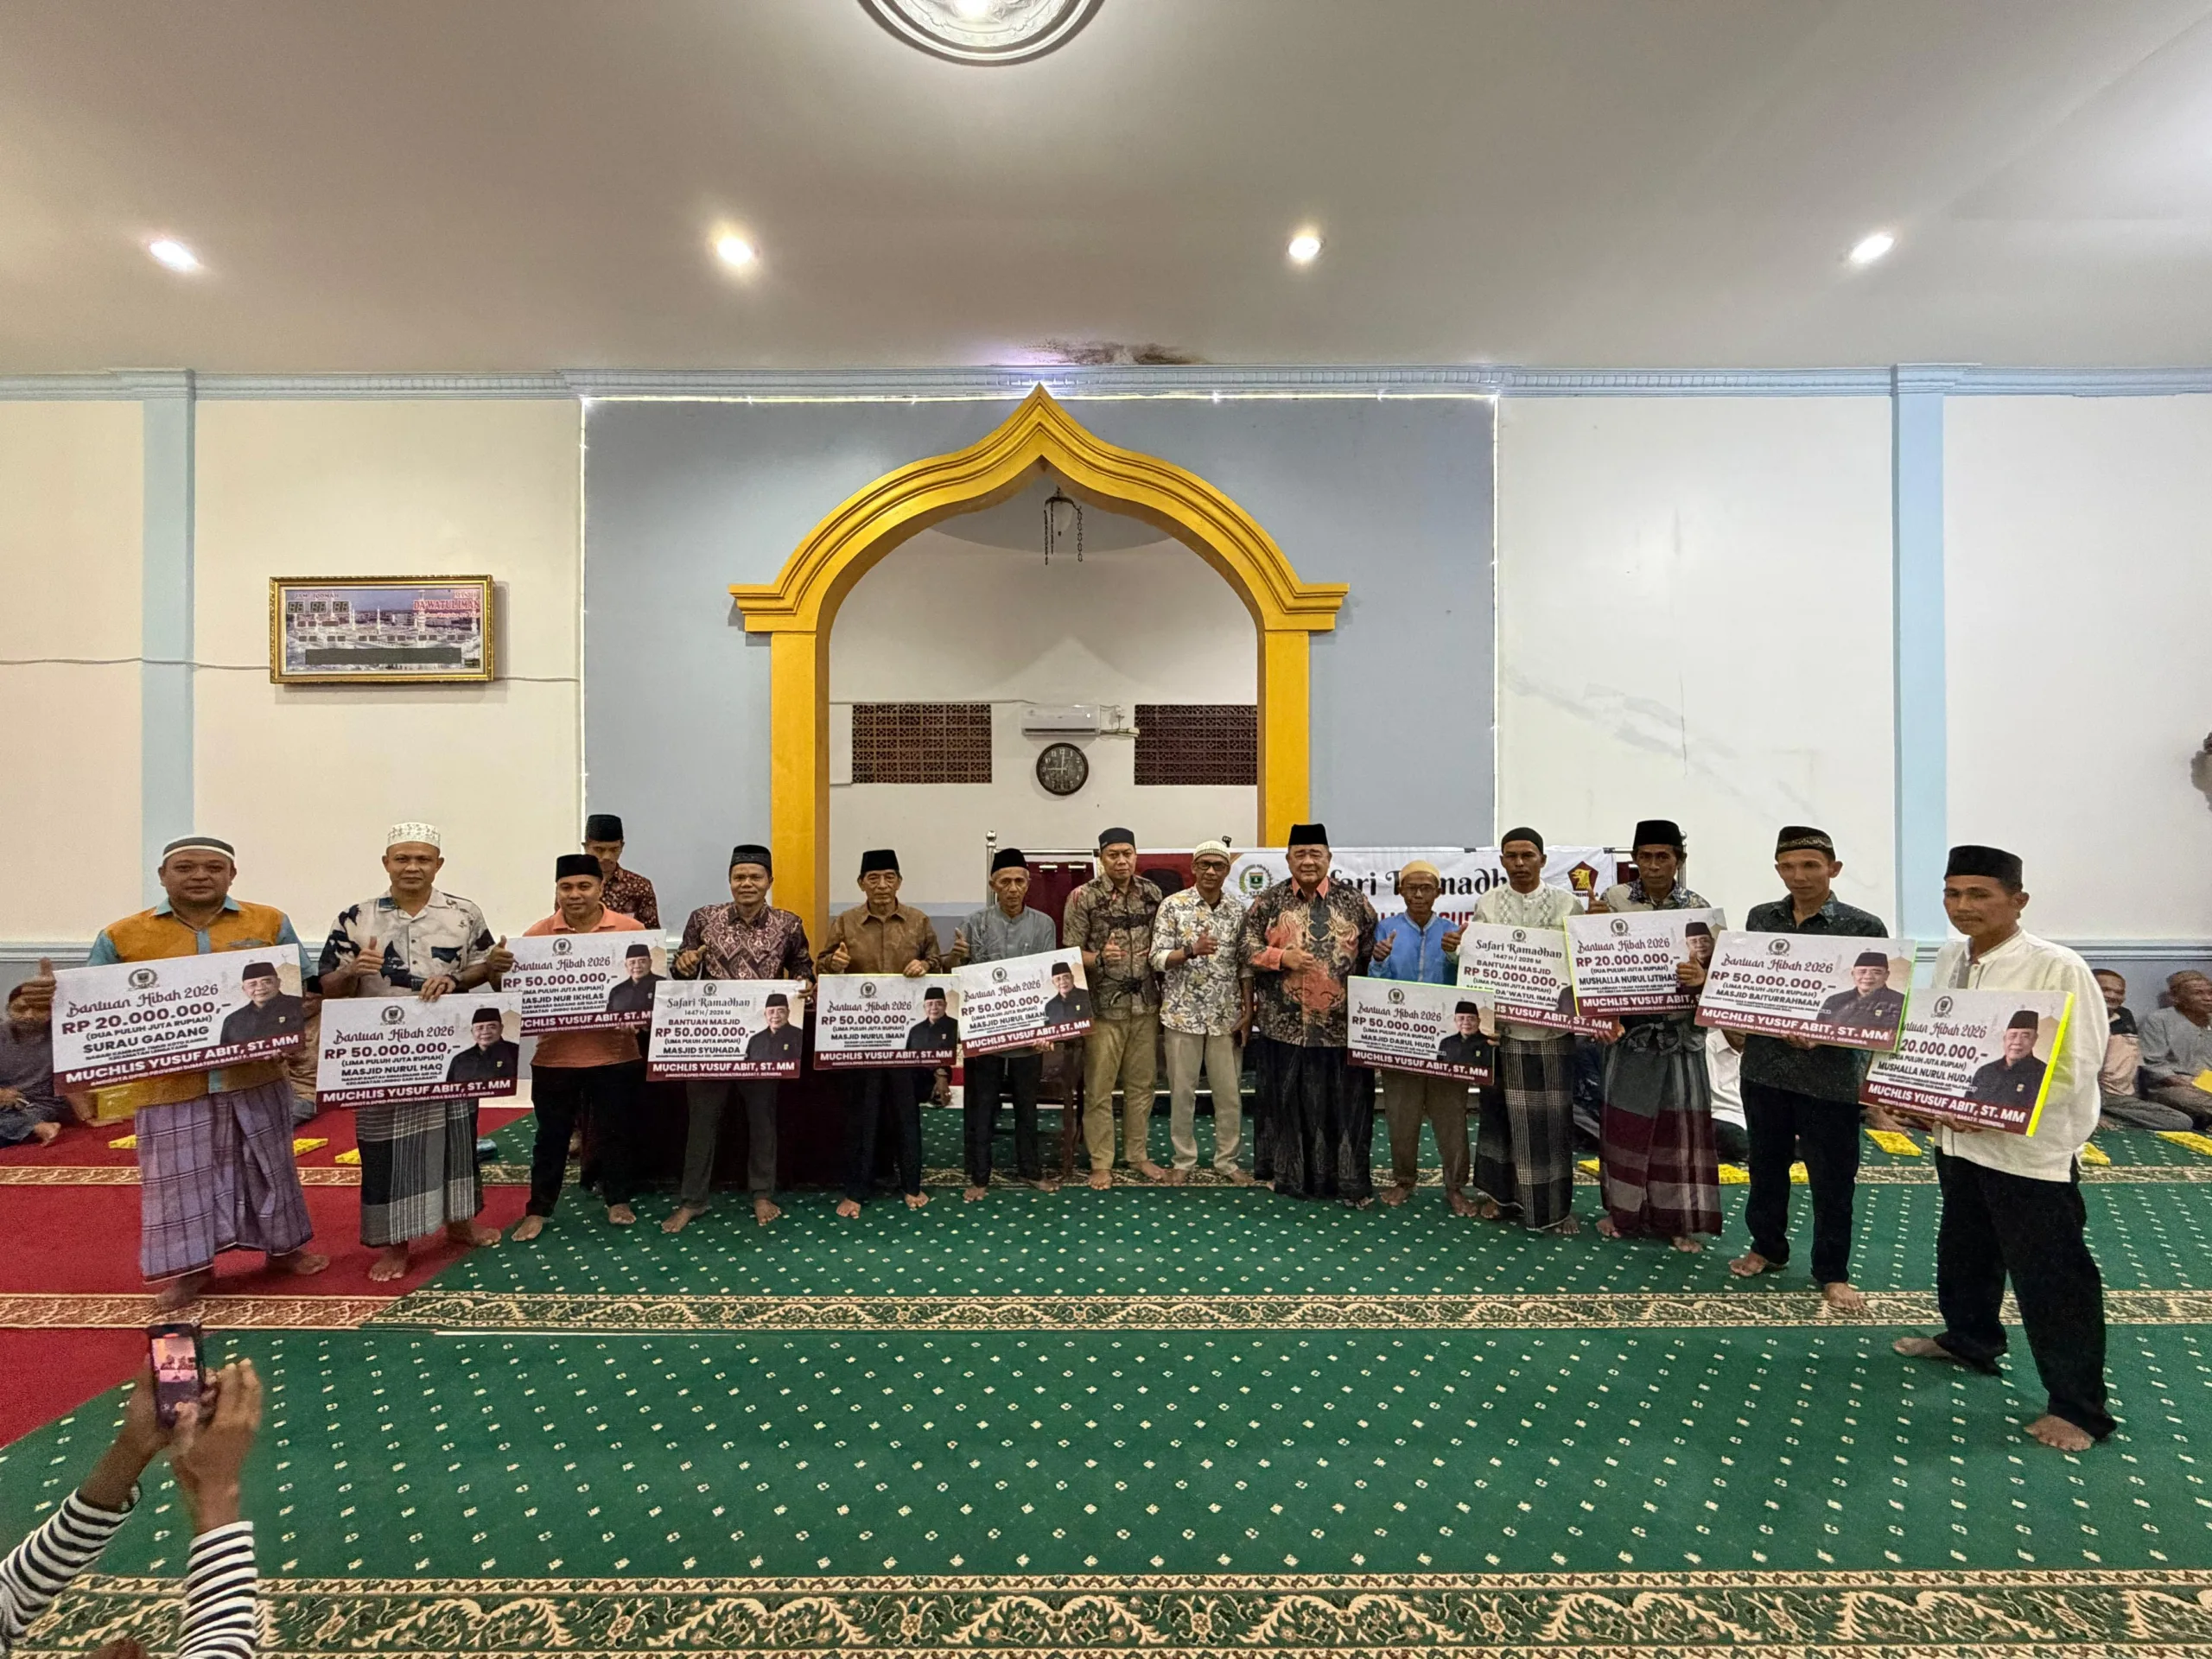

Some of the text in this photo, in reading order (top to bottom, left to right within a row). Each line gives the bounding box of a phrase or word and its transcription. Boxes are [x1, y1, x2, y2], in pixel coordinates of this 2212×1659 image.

[1476, 940, 1562, 958] Safari Ramadhan
[1578, 938, 1670, 953] Bantuan Hibah 2026
[556, 959, 586, 971] Hibah
[588, 957, 610, 966] 2026
[1477, 960, 1551, 975] BANTUAN MASJID
[1576, 957, 1592, 967] RP
[1721, 953, 1834, 974] Bantuan Hibah 2026
[1464, 967, 1479, 976] RP
[1711, 971, 1729, 982] RP
[503, 978, 521, 988] RP
[1580, 976, 1619, 985] MUSHALLA
[964, 980, 1040, 1002] Bantuan Hibah 2026
[1716, 989, 1746, 999] MASJID
[1749, 993, 1821, 1007] BAITURRAHMAN
[67, 983, 219, 1018] Bantuan Hibah 2026
[667, 997, 750, 1008] Safari Ramadhan
[828, 1001, 912, 1013] Bantuan Hibah 2026
[1583, 997, 1629, 1007] MUCHLIS
[1630, 996, 1662, 1006] YUSUF
[1667, 995, 1694, 1005] ABIT,
[1357, 1001, 1441, 1021] Bantuan Hibah 2026
[1509, 1007, 1541, 1019] YUSUF
[1543, 1012, 1571, 1025] ABIT,
[1573, 1017, 1589, 1026] ST.
[1592, 1020, 1612, 1029] MM
[61, 1020, 90, 1034] RP
[86, 1014, 212, 1041] (DUA PULUH JUTA RUPIAH)
[969, 1020, 998, 1029] MASJID
[1000, 1015, 1024, 1025] NURUL
[1026, 1012, 1045, 1020] IMAN
[1352, 1016, 1366, 1026] RP
[1702, 1009, 1887, 1041] MUCHLIS YUSUF ABIT, ST. MM
[83, 1027, 209, 1053] SURAU GADANG
[333, 1026, 454, 1045] Bantuan Hibah 2026
[656, 1028, 671, 1037] RP
[967, 1037, 1006, 1049] MUCHLIS
[1007, 1031, 1034, 1041] YUSUF
[1061, 1023, 1073, 1032] ST.
[1075, 1020, 1090, 1029] MM
[1361, 1034, 1389, 1044] MASJID
[1414, 1040, 1435, 1049] HUDA
[66, 1034, 299, 1084] MUCHLIS YUSUF ABIT, ST. MM
[325, 1048, 346, 1059] RP
[341, 1067, 382, 1077] MASJID
[653, 1063, 697, 1071] MUCHLIS
[700, 1063, 731, 1071] YUSUF
[734, 1063, 759, 1071] ABIT,
[777, 1062, 795, 1071] MM
[1352, 1051, 1393, 1064] MUCHLIS
[1395, 1056, 1425, 1067] YUSUF
[1427, 1062, 1452, 1072] ABIT,
[1470, 1068, 1488, 1077] MM
[1878, 1063, 1918, 1076] MUSHALLA
[1921, 1068, 1947, 1079] NURUL
[1948, 1072, 1974, 1084] HUDA
[323, 1079, 511, 1103] MUCHLIS YUSUF ABIT, ST. MM
[1868, 1084, 1911, 1102] MUCHLIS
[1914, 1091, 1947, 1108] YUSUF
[1948, 1100, 1979, 1117] ABIT,
[1981, 1105, 1999, 1119] ST.
[2002, 1110, 2025, 1123] MM
